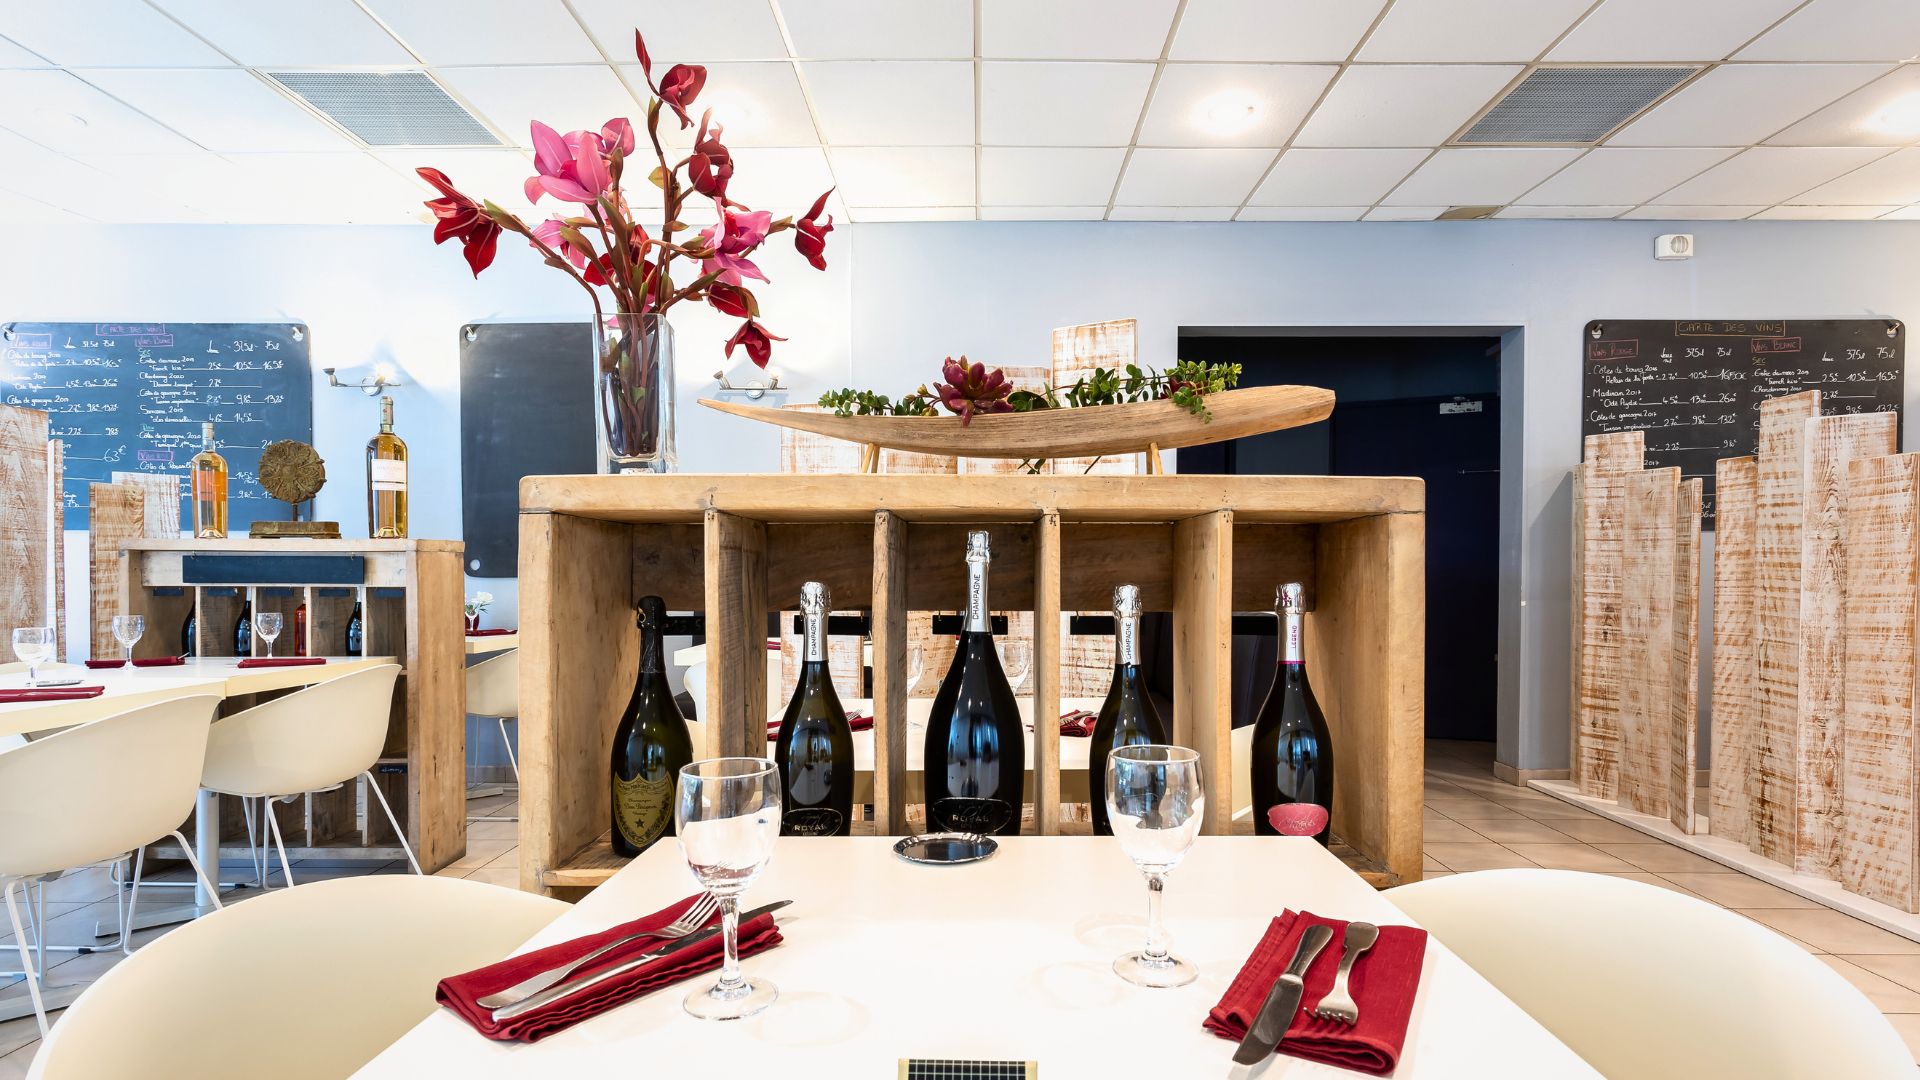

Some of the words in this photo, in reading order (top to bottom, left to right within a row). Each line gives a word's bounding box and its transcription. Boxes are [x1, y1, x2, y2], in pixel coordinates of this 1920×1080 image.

[1678, 322, 1713, 332] CARTE
[1722, 322, 1746, 333] DES
[1755, 322, 1783, 333] VINS
[973, 574, 981, 620] CHAMPAGNE
[952, 813, 990, 822] ROYAL
[793, 823, 826, 832] ROYAL
